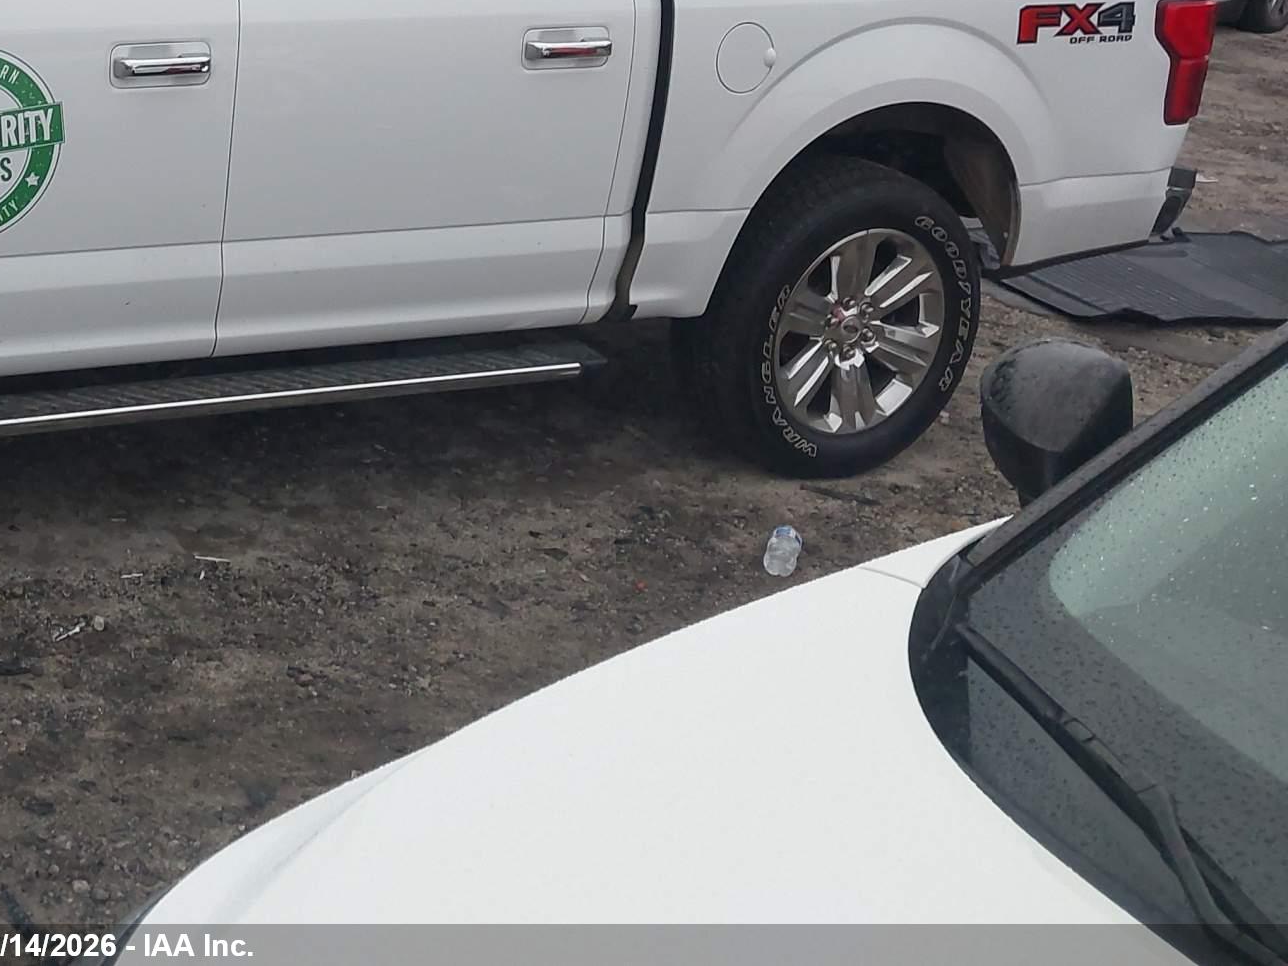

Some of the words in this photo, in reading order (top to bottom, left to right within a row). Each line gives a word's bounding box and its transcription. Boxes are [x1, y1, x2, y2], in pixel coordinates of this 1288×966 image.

[1016, 1, 1136, 45] FX4
[1069, 35, 1095, 45] OFF
[1099, 34, 1133, 43] ROAD
[914, 215, 972, 392] GOODYEAR
[761, 284, 817, 458] WRANGLER
